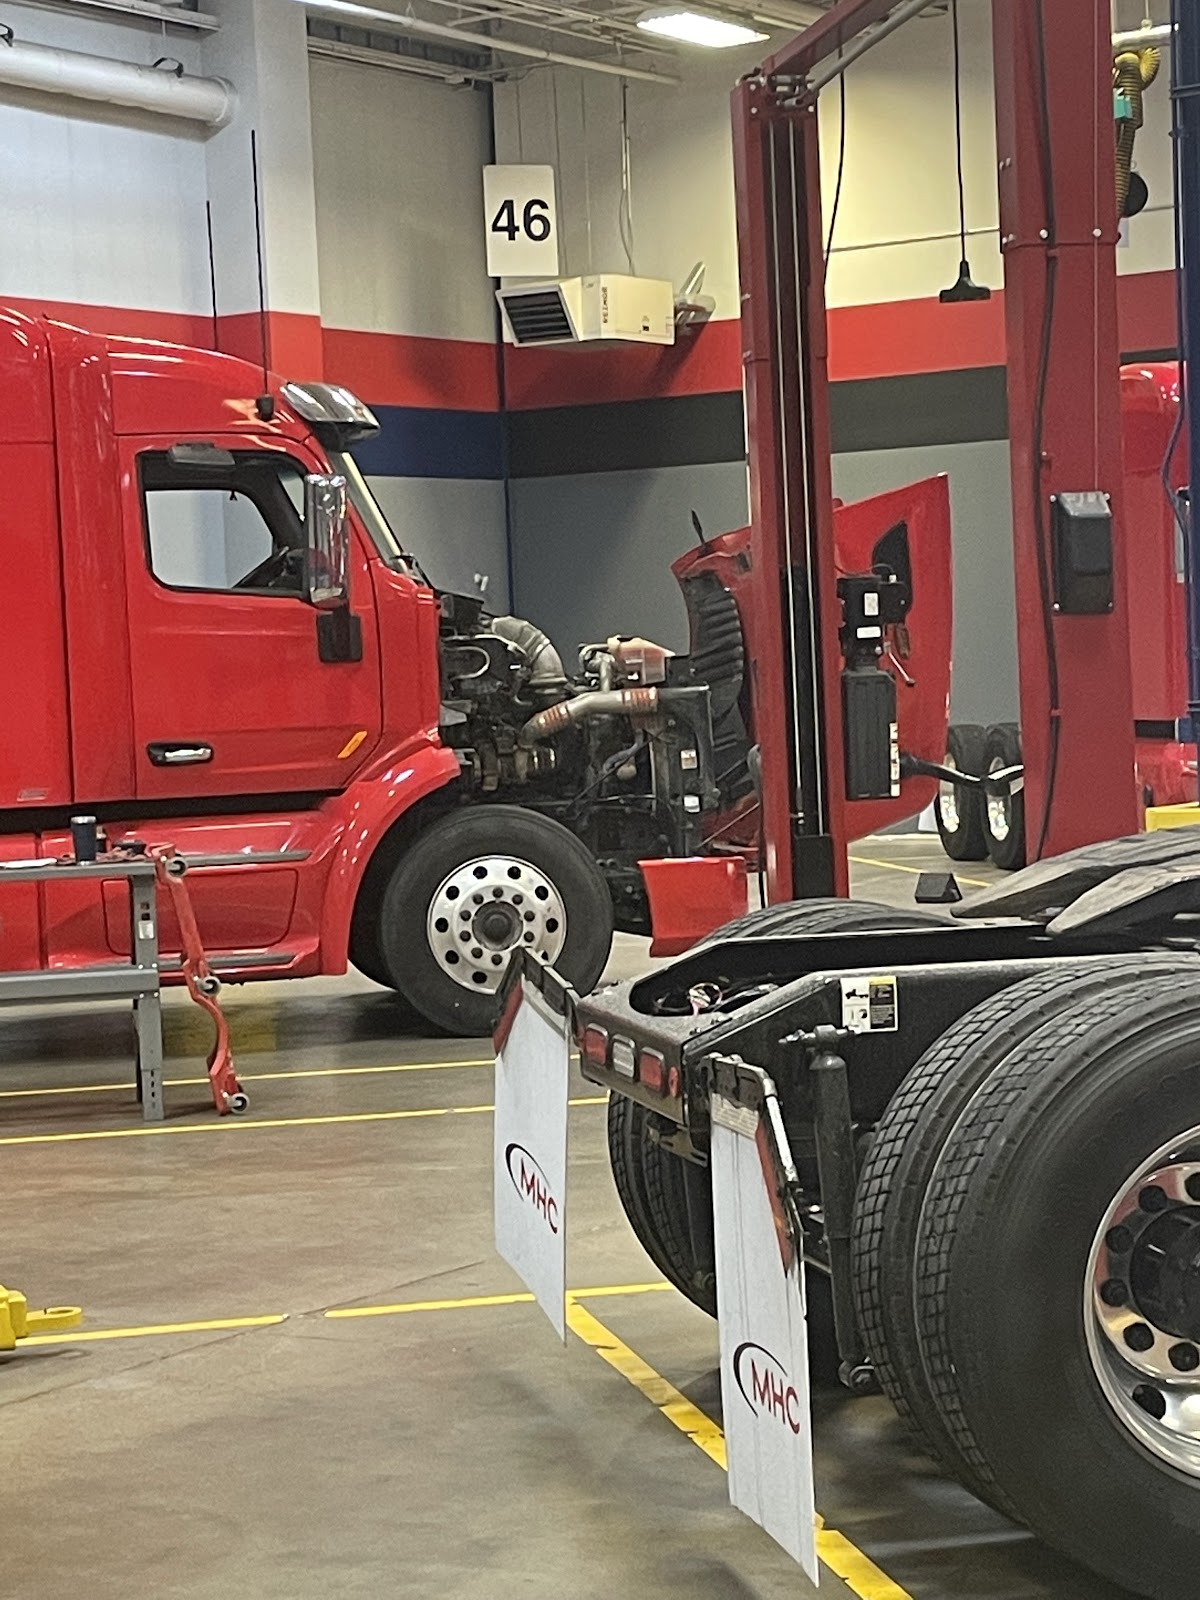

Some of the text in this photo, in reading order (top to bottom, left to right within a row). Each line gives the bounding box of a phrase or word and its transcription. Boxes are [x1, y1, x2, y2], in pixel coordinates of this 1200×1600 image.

[491, 198, 551, 242] 46
[519, 1157, 558, 1234] MHC
[751, 1358, 800, 1434] MHC
